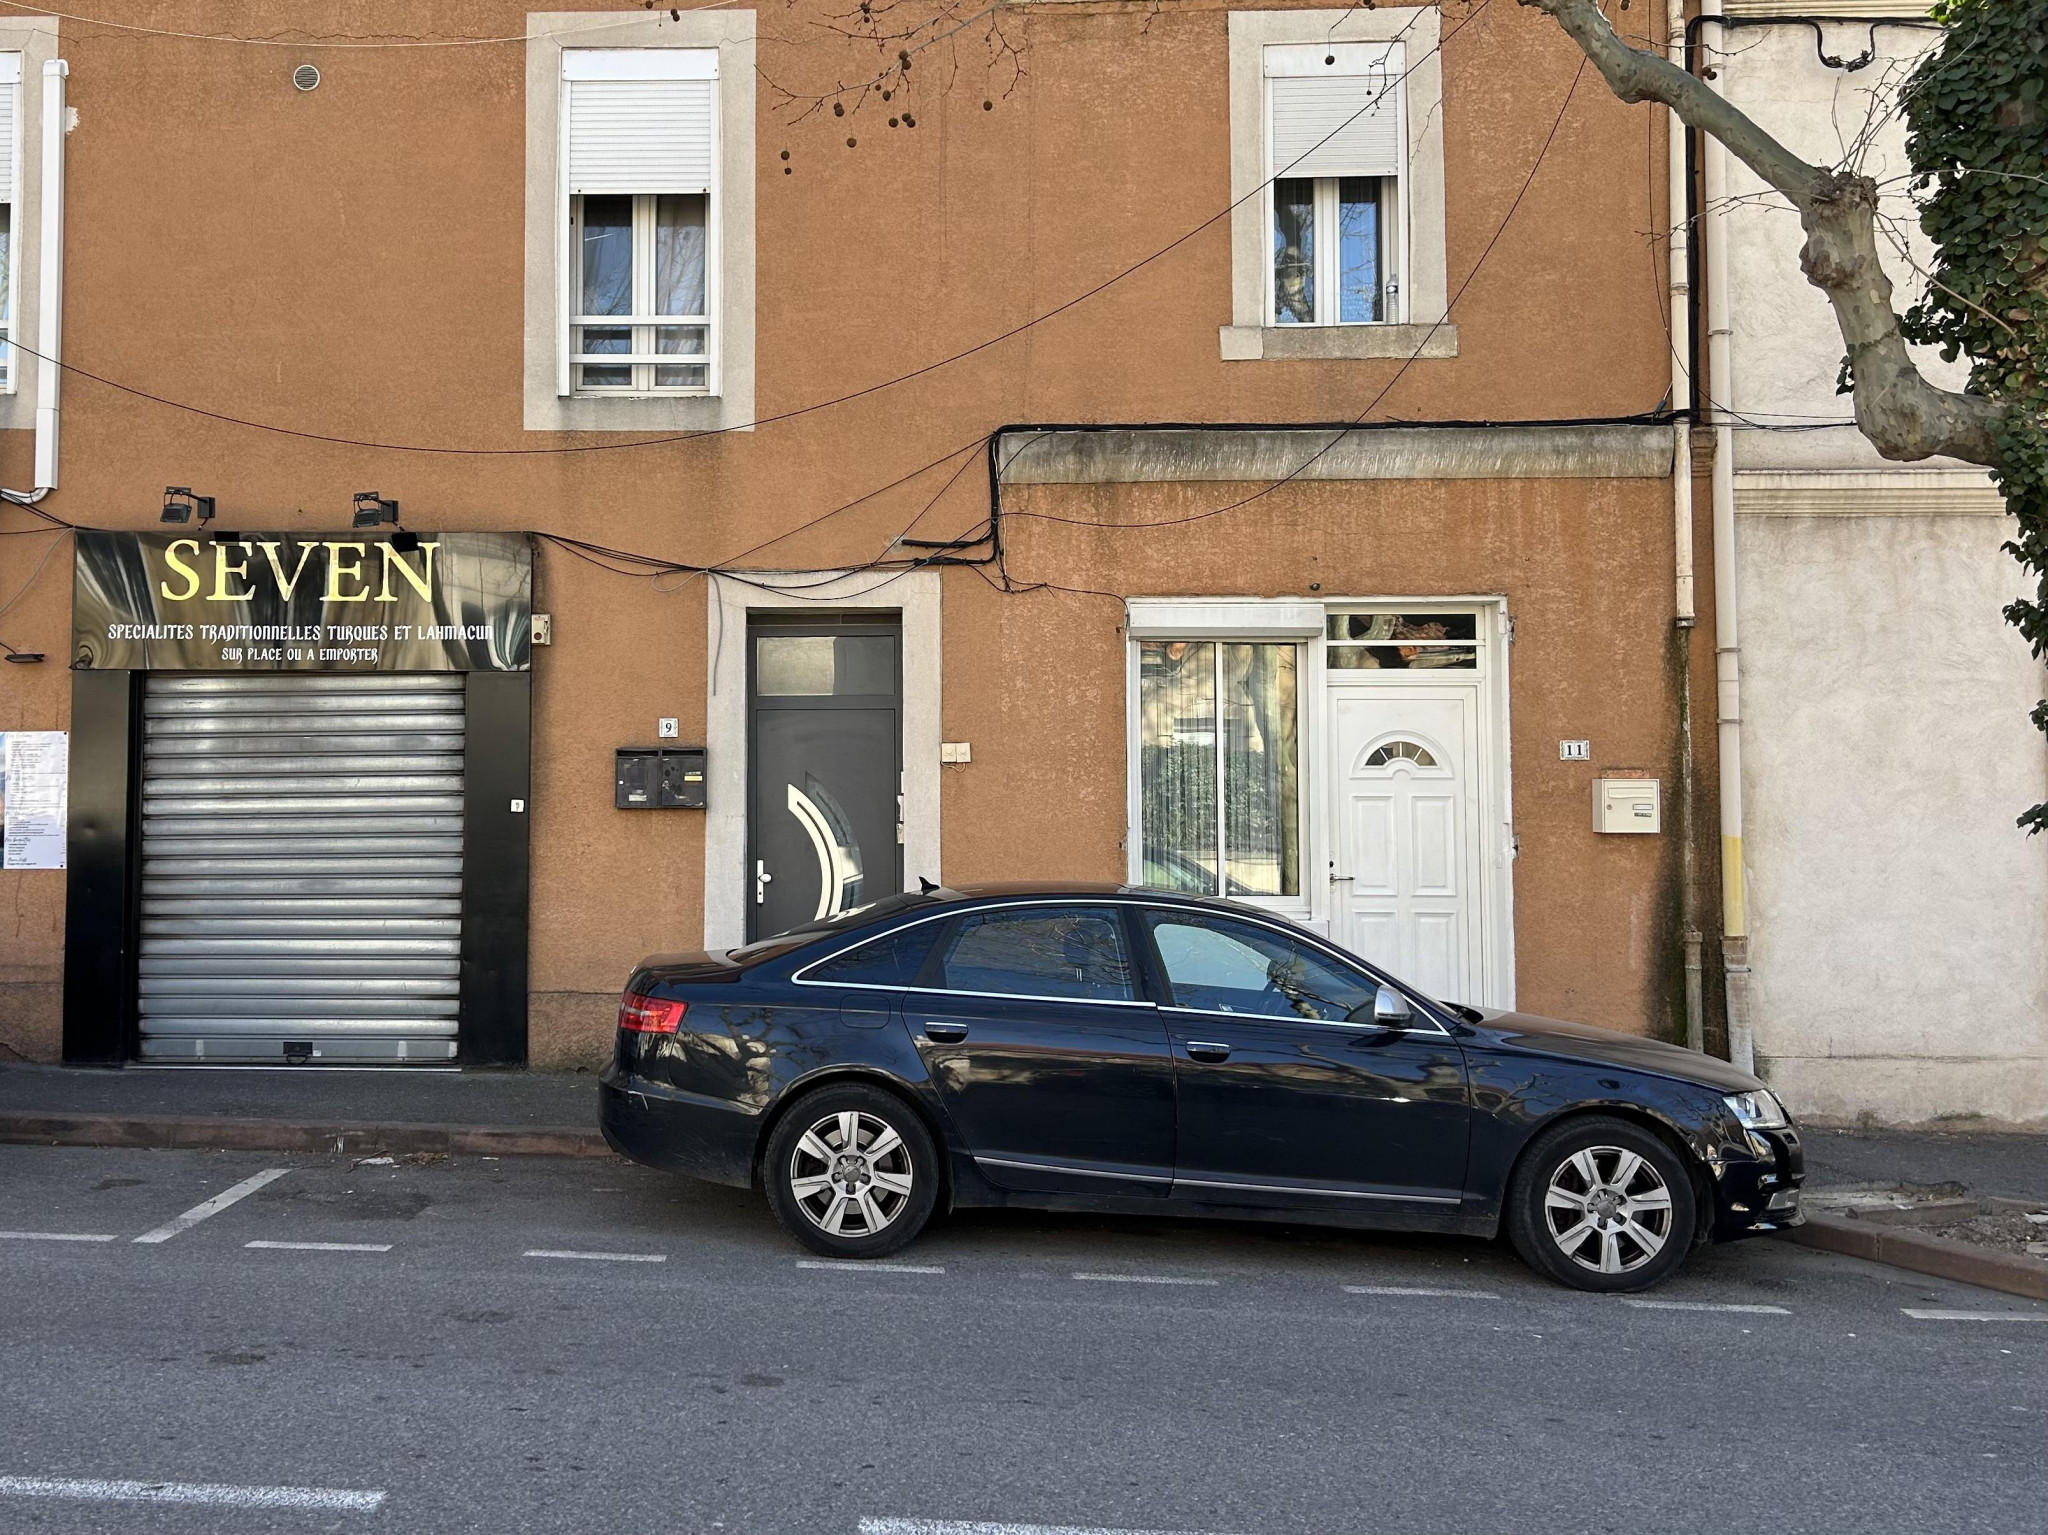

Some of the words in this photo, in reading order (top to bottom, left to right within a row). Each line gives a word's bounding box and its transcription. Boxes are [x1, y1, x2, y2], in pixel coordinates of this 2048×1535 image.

[161, 539, 440, 602] SEVEN
[107, 623, 194, 640] SPECIALITES
[199, 624, 321, 645] TRADITIONNELLES
[327, 625, 388, 645] TURQUES
[394, 625, 413, 641] ET
[417, 625, 494, 641] LAHMACUN
[221, 647, 243, 664] SUR
[247, 647, 283, 661] PLACE
[287, 648, 303, 661] OU
[306, 648, 315, 661] A
[319, 648, 378, 664] EMPORTER
[665, 722, 672, 732] 9
[1567, 744, 1582, 756] 11
